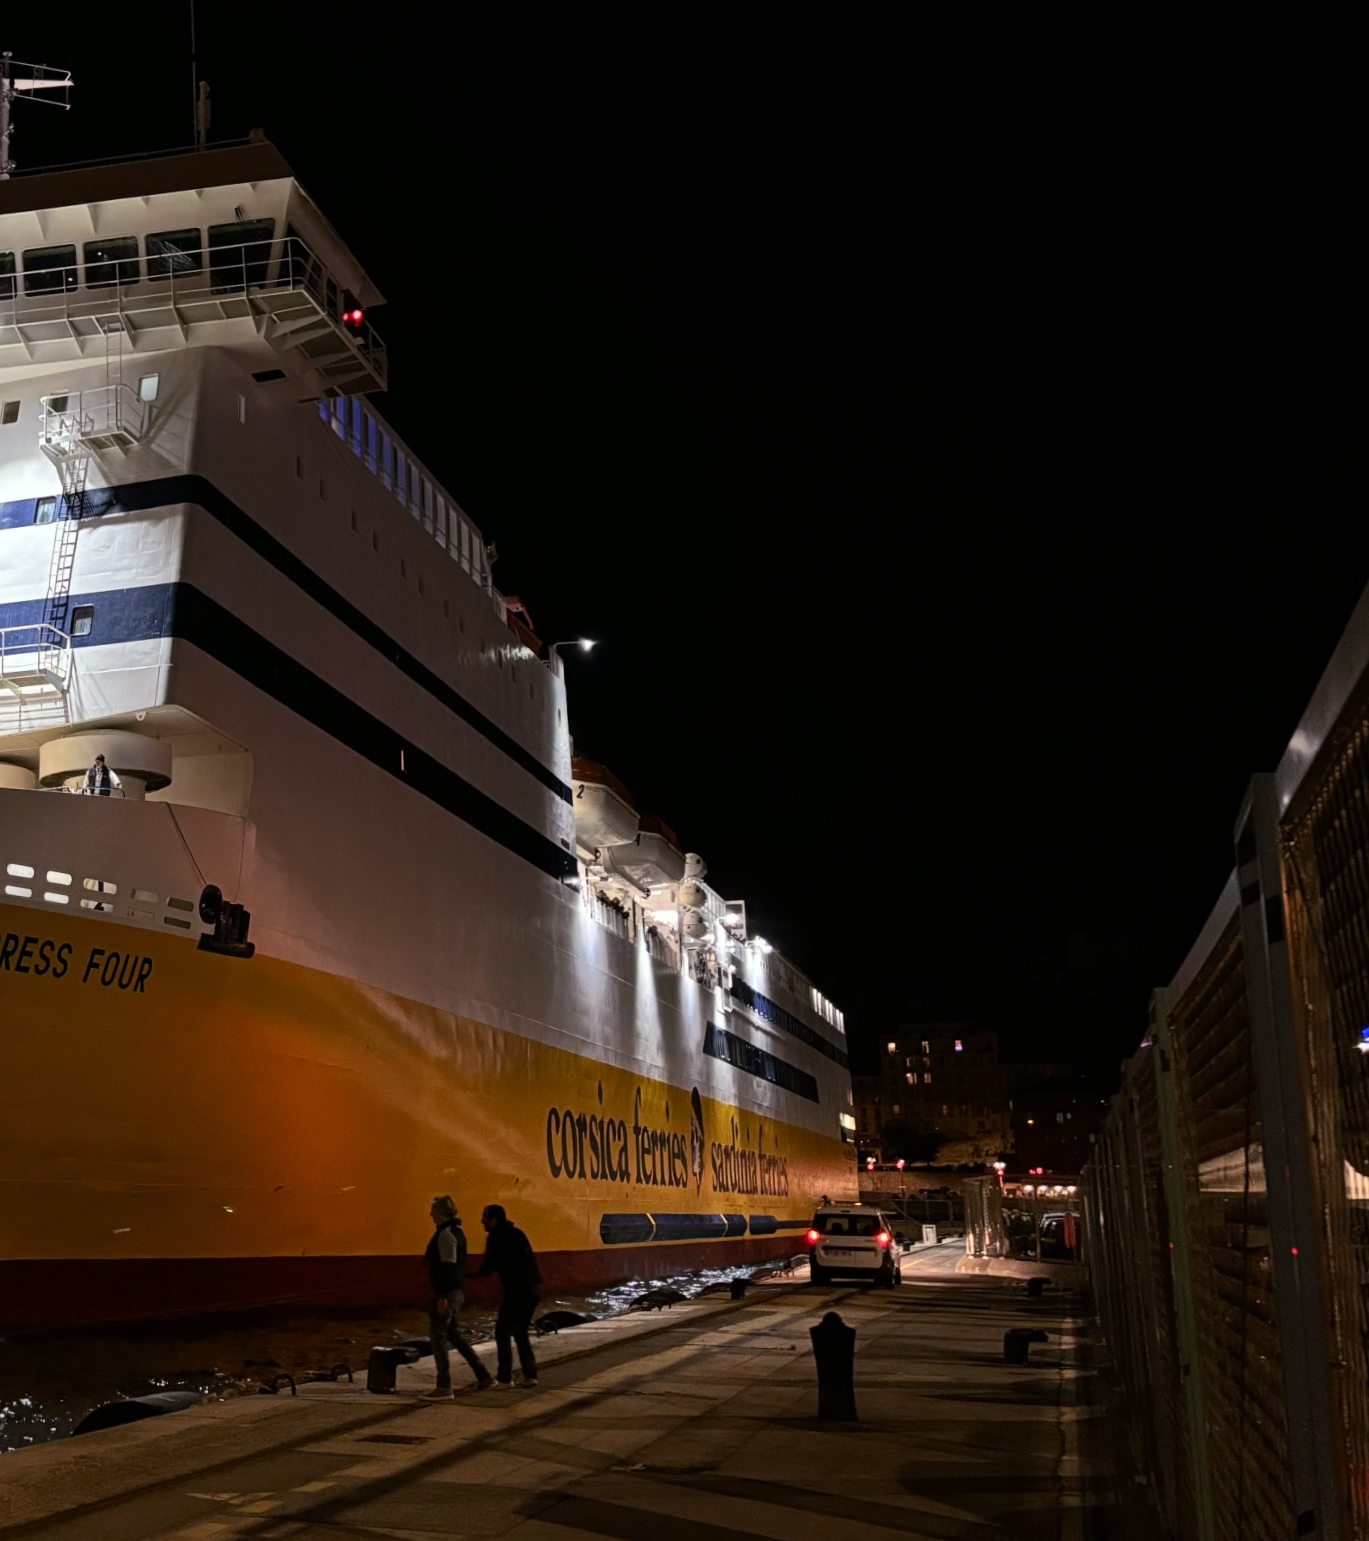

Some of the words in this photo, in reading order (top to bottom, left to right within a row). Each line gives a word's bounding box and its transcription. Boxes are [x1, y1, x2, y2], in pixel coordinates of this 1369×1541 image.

[576, 784, 585, 799] 2
[81, 948, 154, 993] FOUR
[546, 1079, 630, 1184] corsica
[633, 1085, 688, 1188] ferries
[711, 1113, 758, 1195] sardinia
[758, 1124, 789, 1197] ferries
